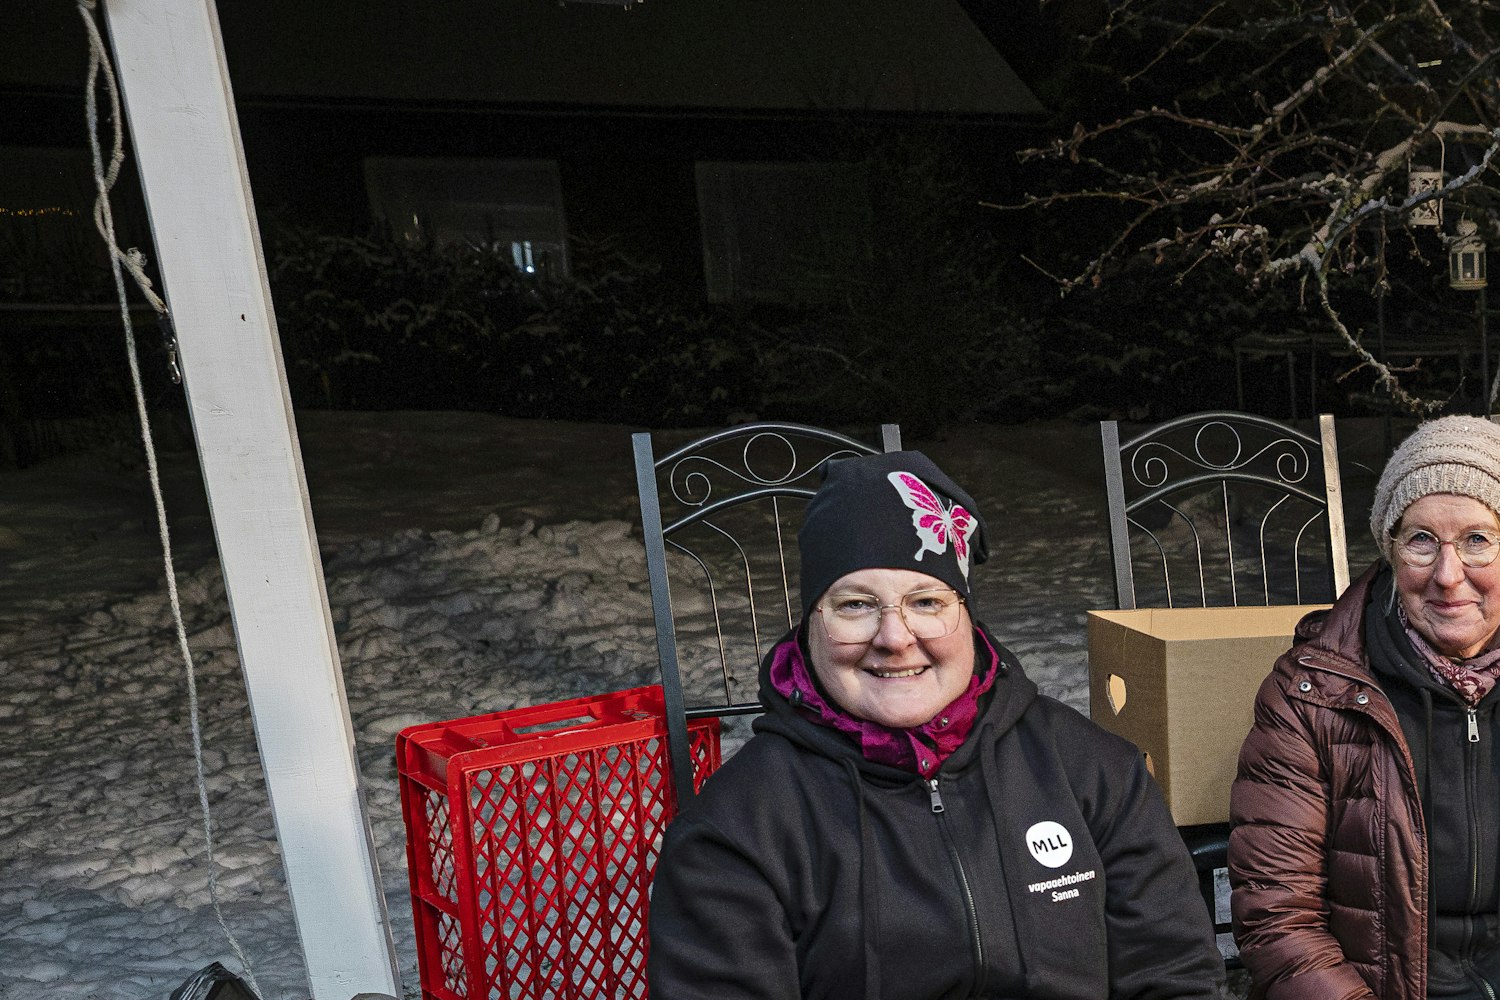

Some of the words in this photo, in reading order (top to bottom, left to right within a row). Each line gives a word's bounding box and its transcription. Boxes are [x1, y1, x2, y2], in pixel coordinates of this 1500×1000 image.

[1032, 834, 1068, 855] MLL
[1028, 869, 1096, 894] vapaaehtoinen
[1051, 888, 1080, 903] Sanna
